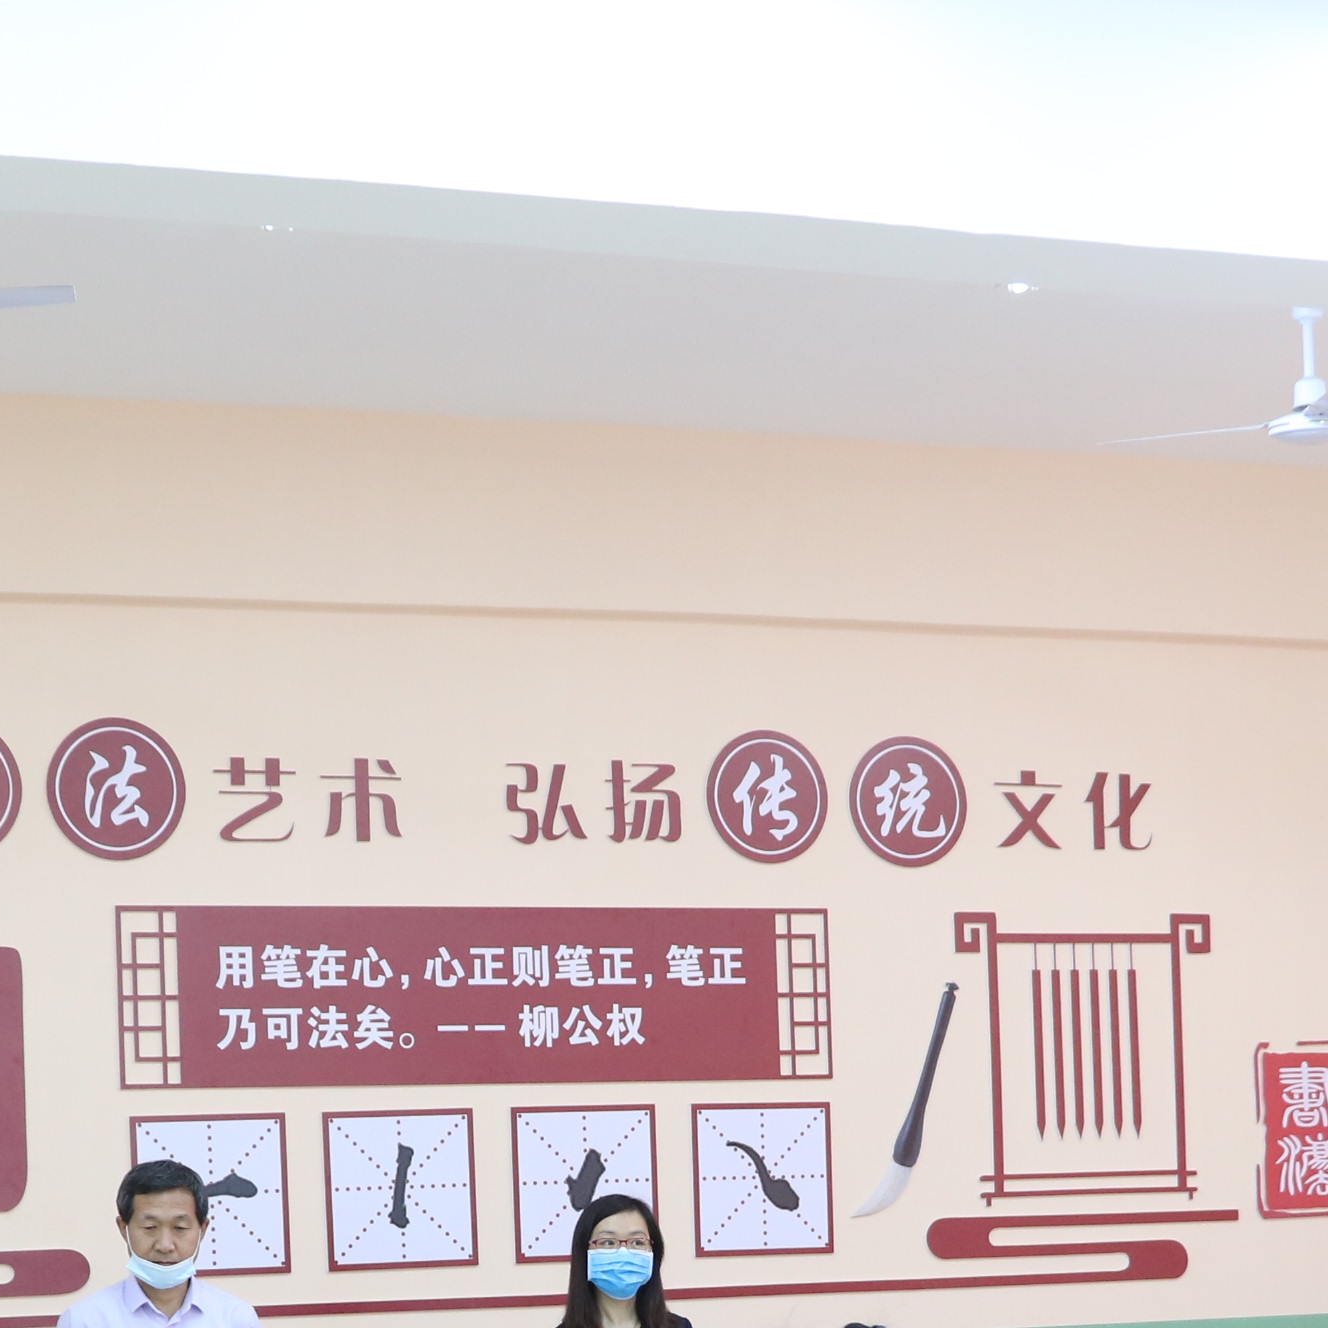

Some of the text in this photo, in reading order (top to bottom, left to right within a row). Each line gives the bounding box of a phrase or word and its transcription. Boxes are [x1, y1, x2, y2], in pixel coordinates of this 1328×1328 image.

[506, 755, 1153, 852] 弘扬传统文化
